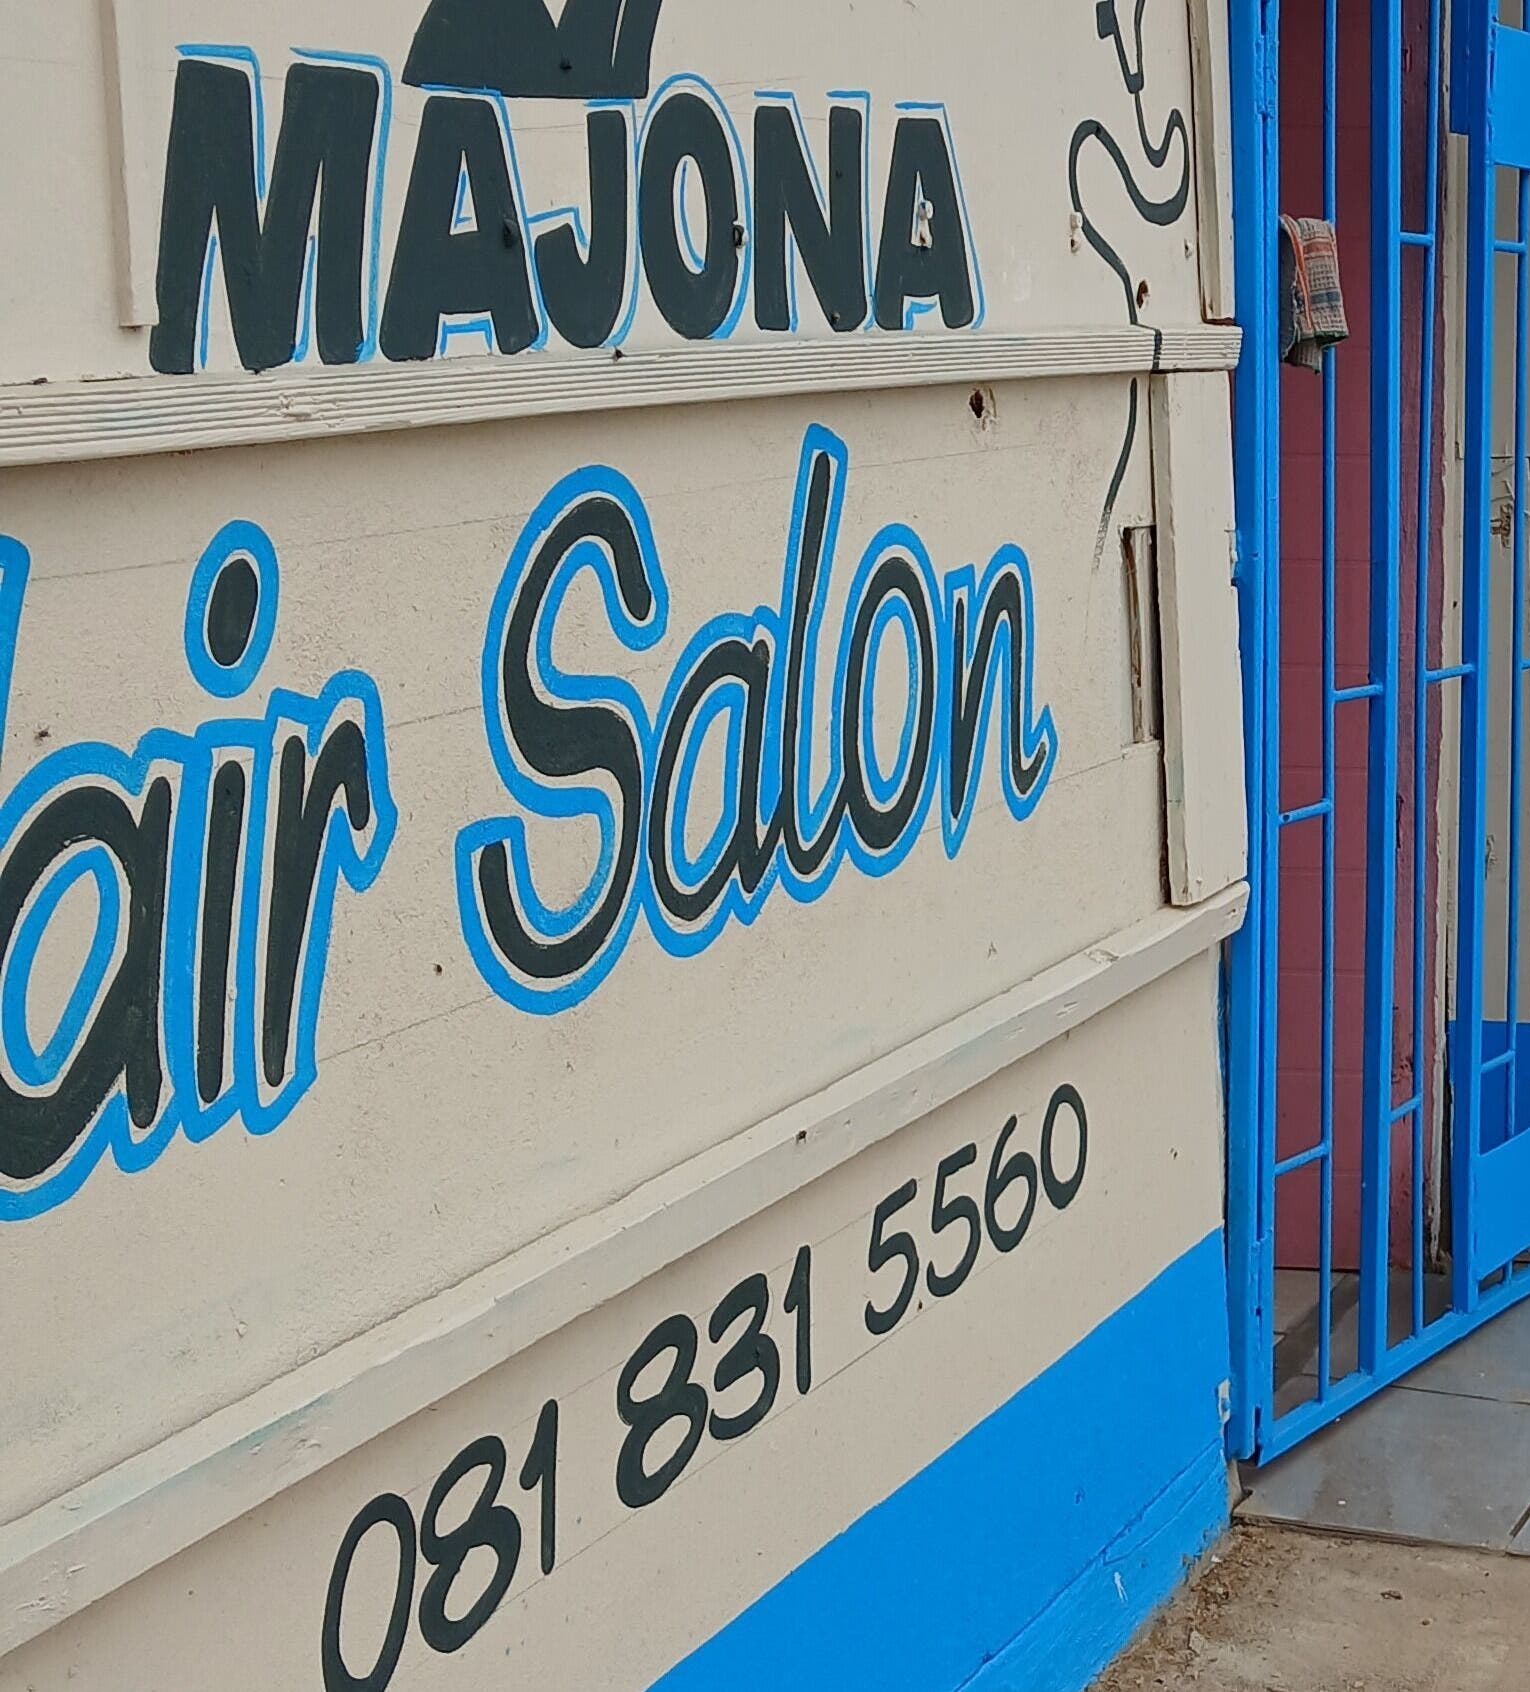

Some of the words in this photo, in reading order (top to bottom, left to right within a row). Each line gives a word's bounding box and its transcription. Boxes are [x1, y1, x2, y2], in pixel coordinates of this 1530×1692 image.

[150, 45, 984, 375] MAJONA
[0, 520, 397, 1221] air
[455, 424, 1057, 1016] Salon
[322, 1400, 559, 1692] 081
[616, 1245, 812, 1508] 831
[864, 1084, 1088, 1335] 5560
